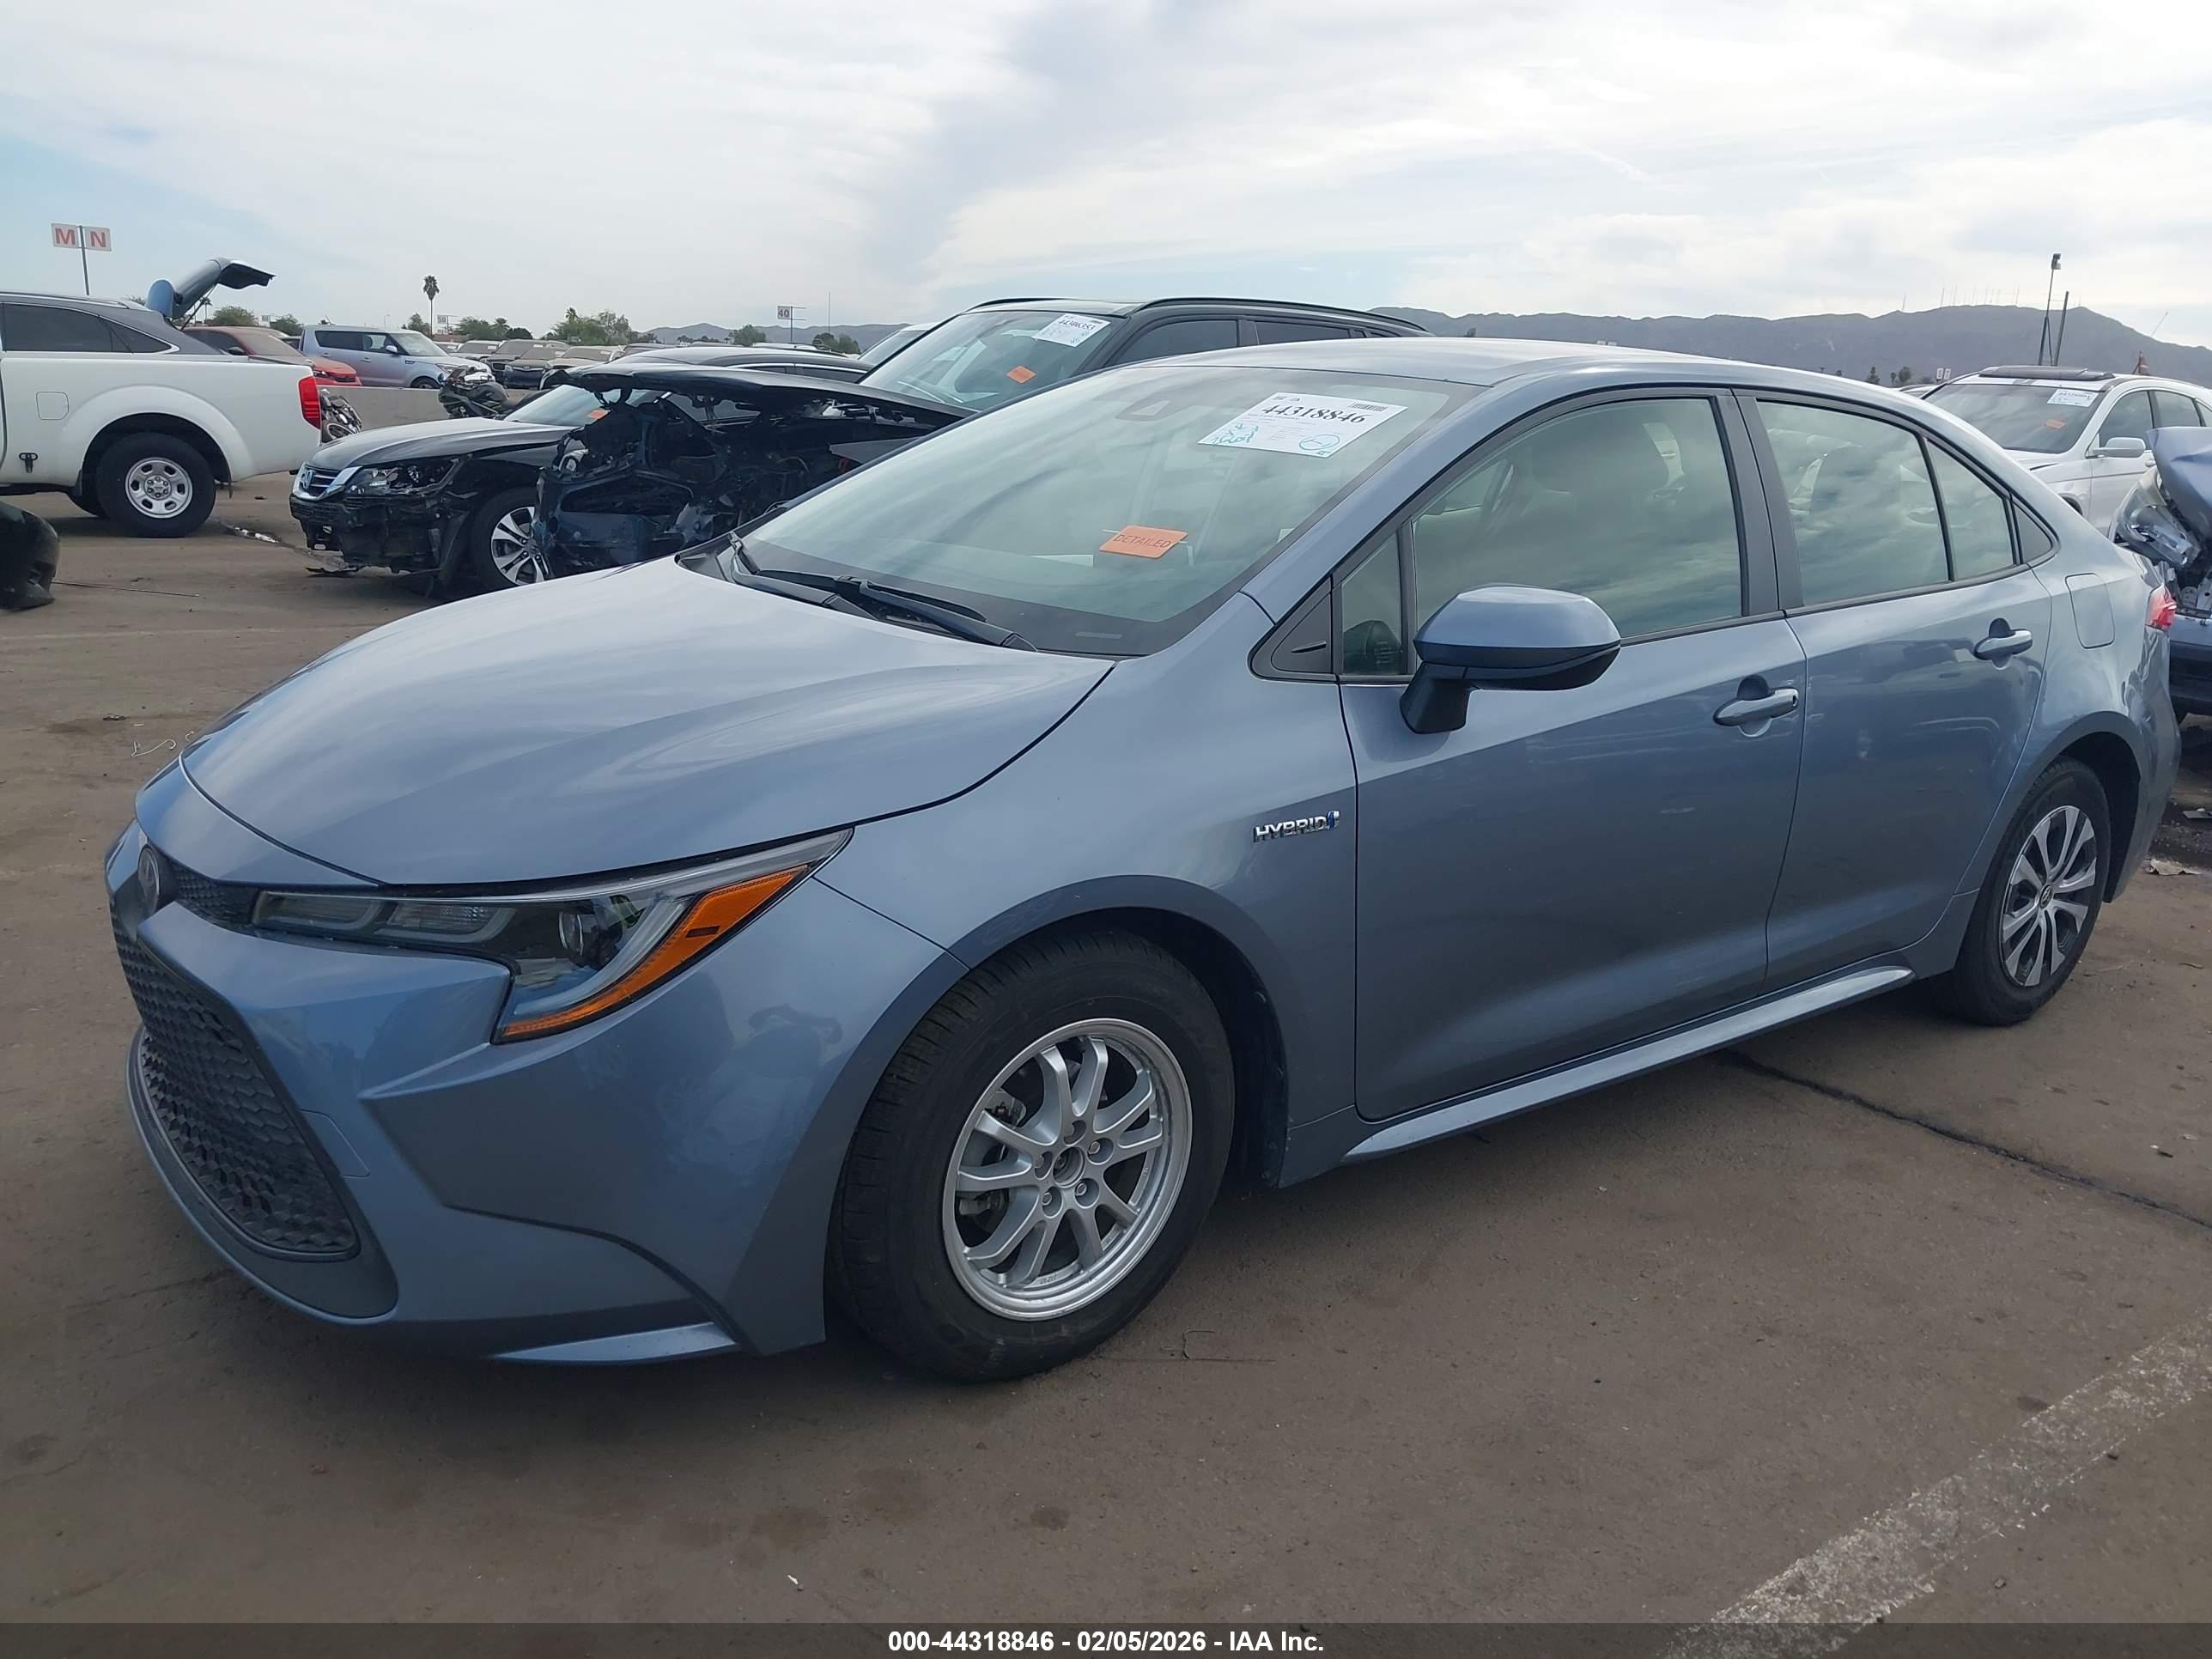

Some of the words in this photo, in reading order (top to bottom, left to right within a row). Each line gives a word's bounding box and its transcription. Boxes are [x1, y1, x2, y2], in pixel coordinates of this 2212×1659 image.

[55, 228, 76, 245] M
[89, 231, 106, 247] N
[778, 308, 790, 318] 40
[1261, 404, 1367, 424] 44318846
[1113, 534, 1173, 548] DETAILED
[1254, 816, 1328, 842] HYBRID
